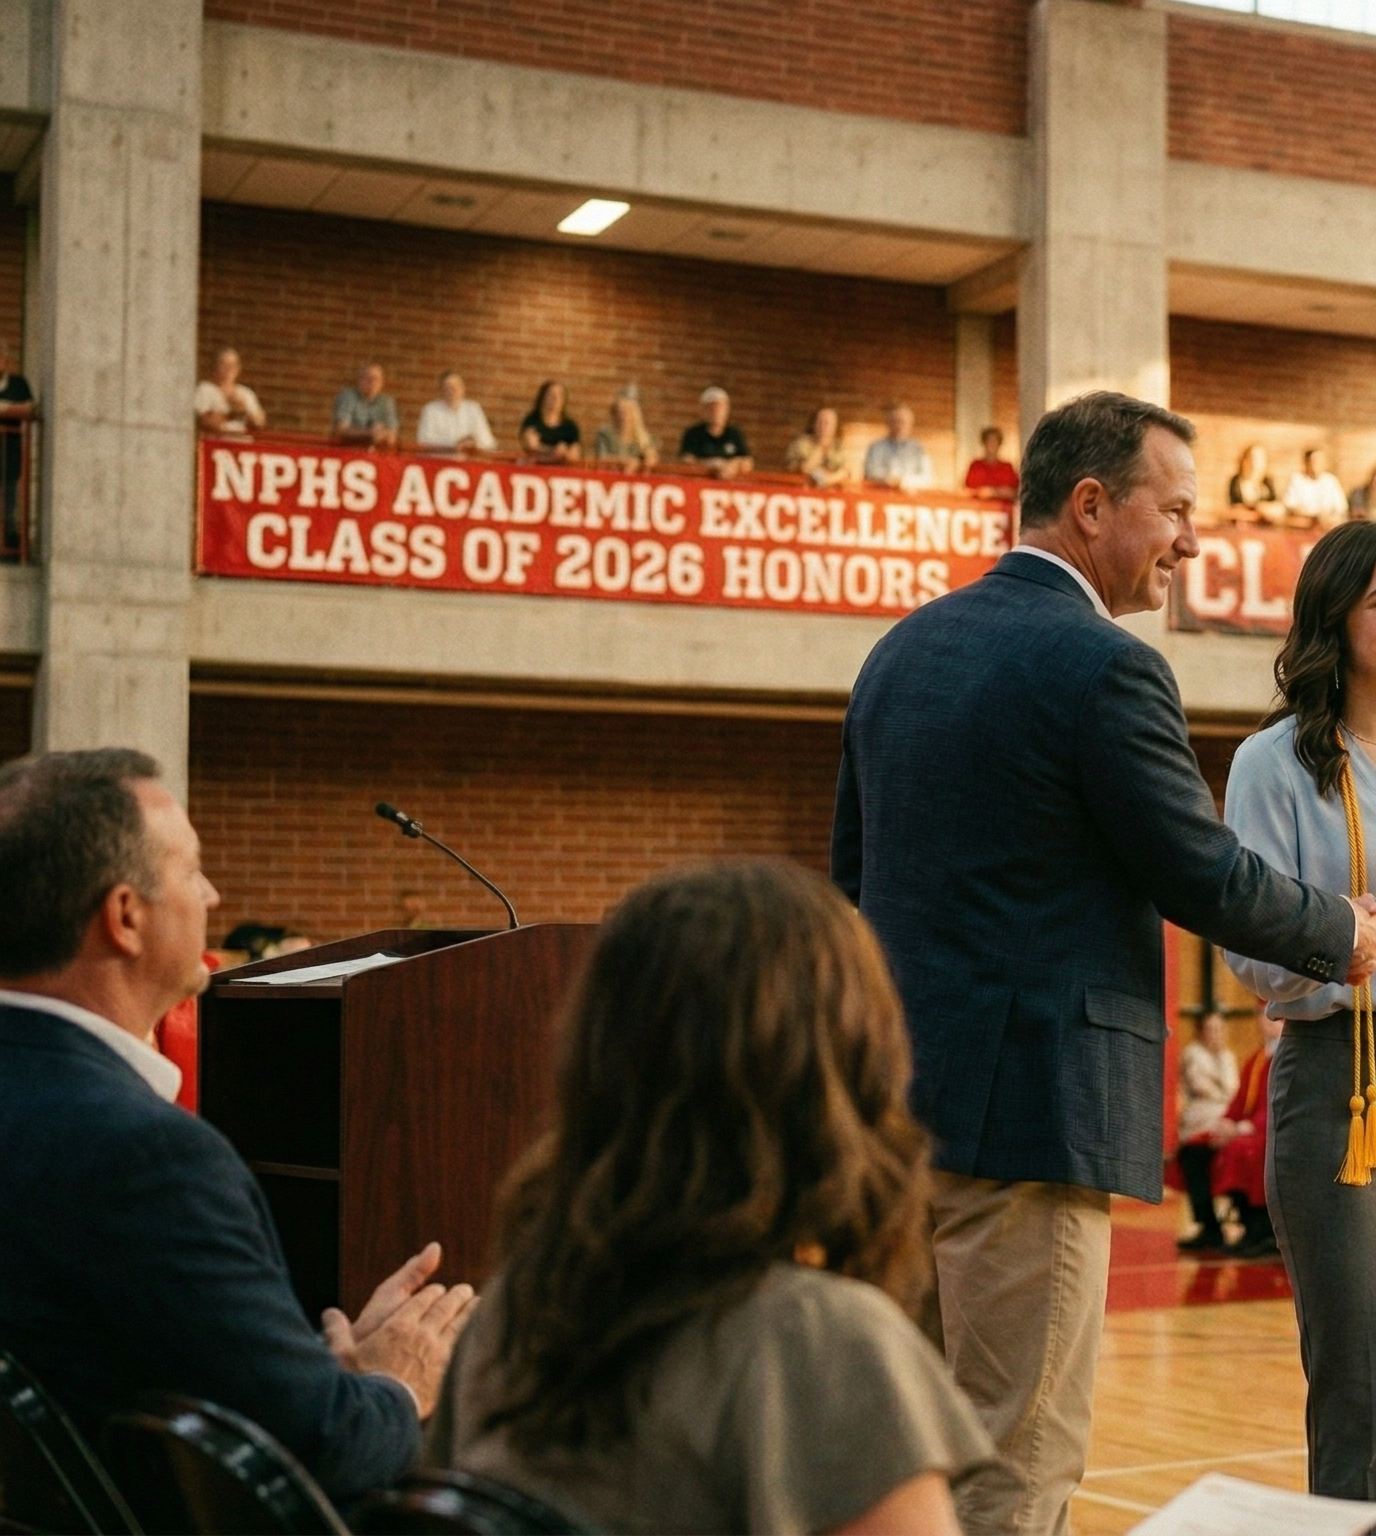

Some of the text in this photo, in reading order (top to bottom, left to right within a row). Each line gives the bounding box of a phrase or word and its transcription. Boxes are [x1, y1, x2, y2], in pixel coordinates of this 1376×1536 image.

[211, 448, 1010, 558] NPHS ACADEMIC EXCELLENCE
[246, 511, 952, 610] CLASS OF 2026 HONORS
